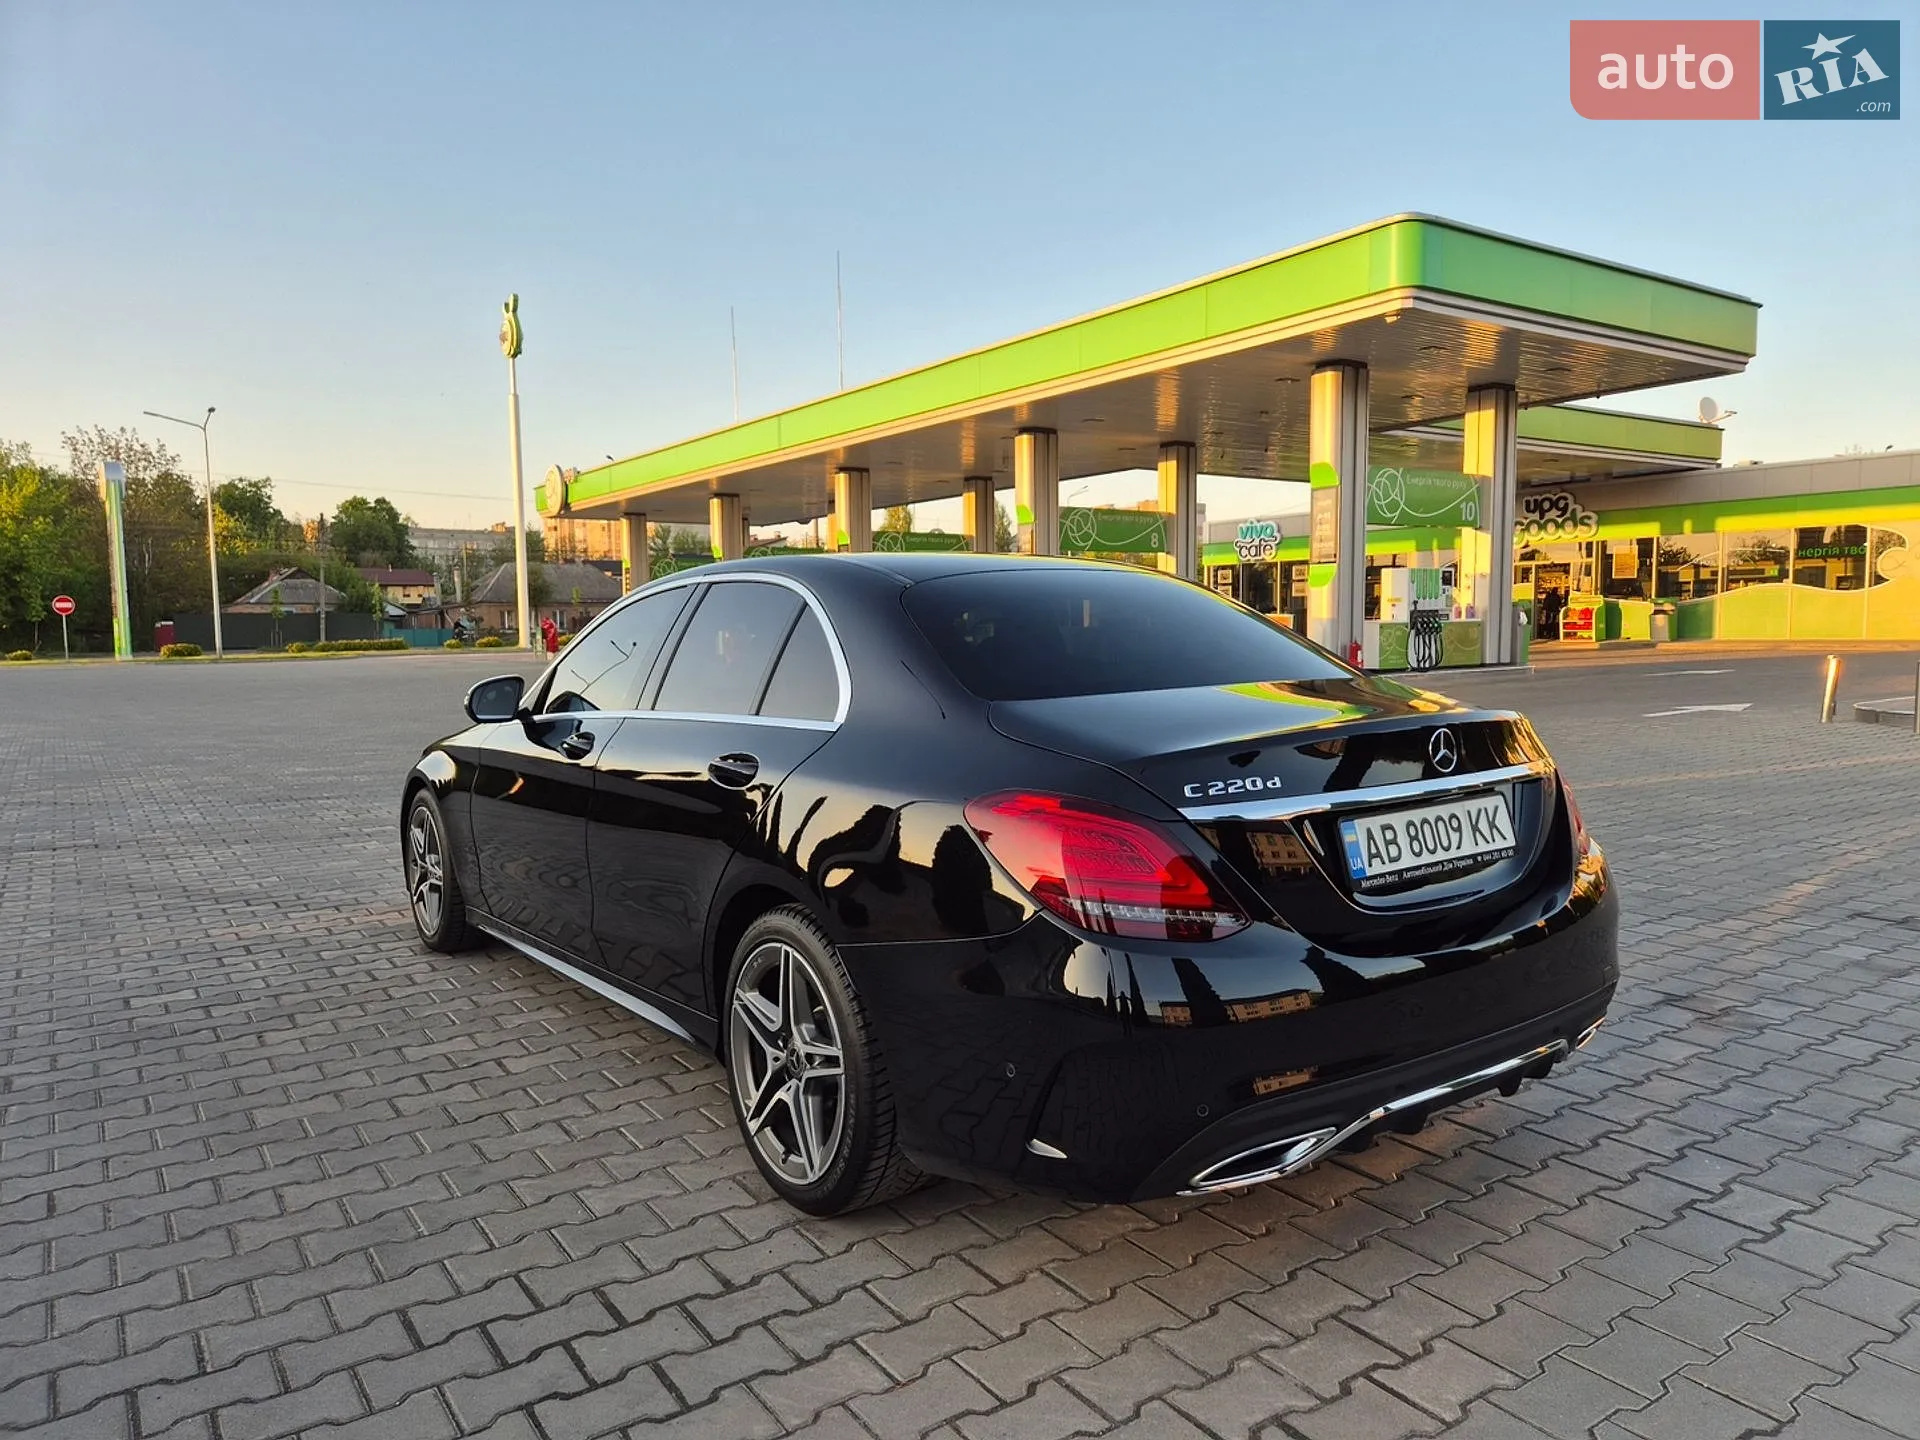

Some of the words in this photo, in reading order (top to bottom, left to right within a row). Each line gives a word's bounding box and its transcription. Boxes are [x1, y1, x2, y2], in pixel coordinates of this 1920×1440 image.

[1460, 501, 1476, 521] 10
[1525, 494, 1569, 520] upg
[1240, 520, 1275, 539] vivo
[1150, 532, 1159, 548] 8
[1183, 783, 1204, 798] C
[1365, 822, 1402, 868] AB
[1405, 812, 1463, 858] 8009
[1466, 805, 1507, 847] KK
[1351, 857, 1364, 871] UA
